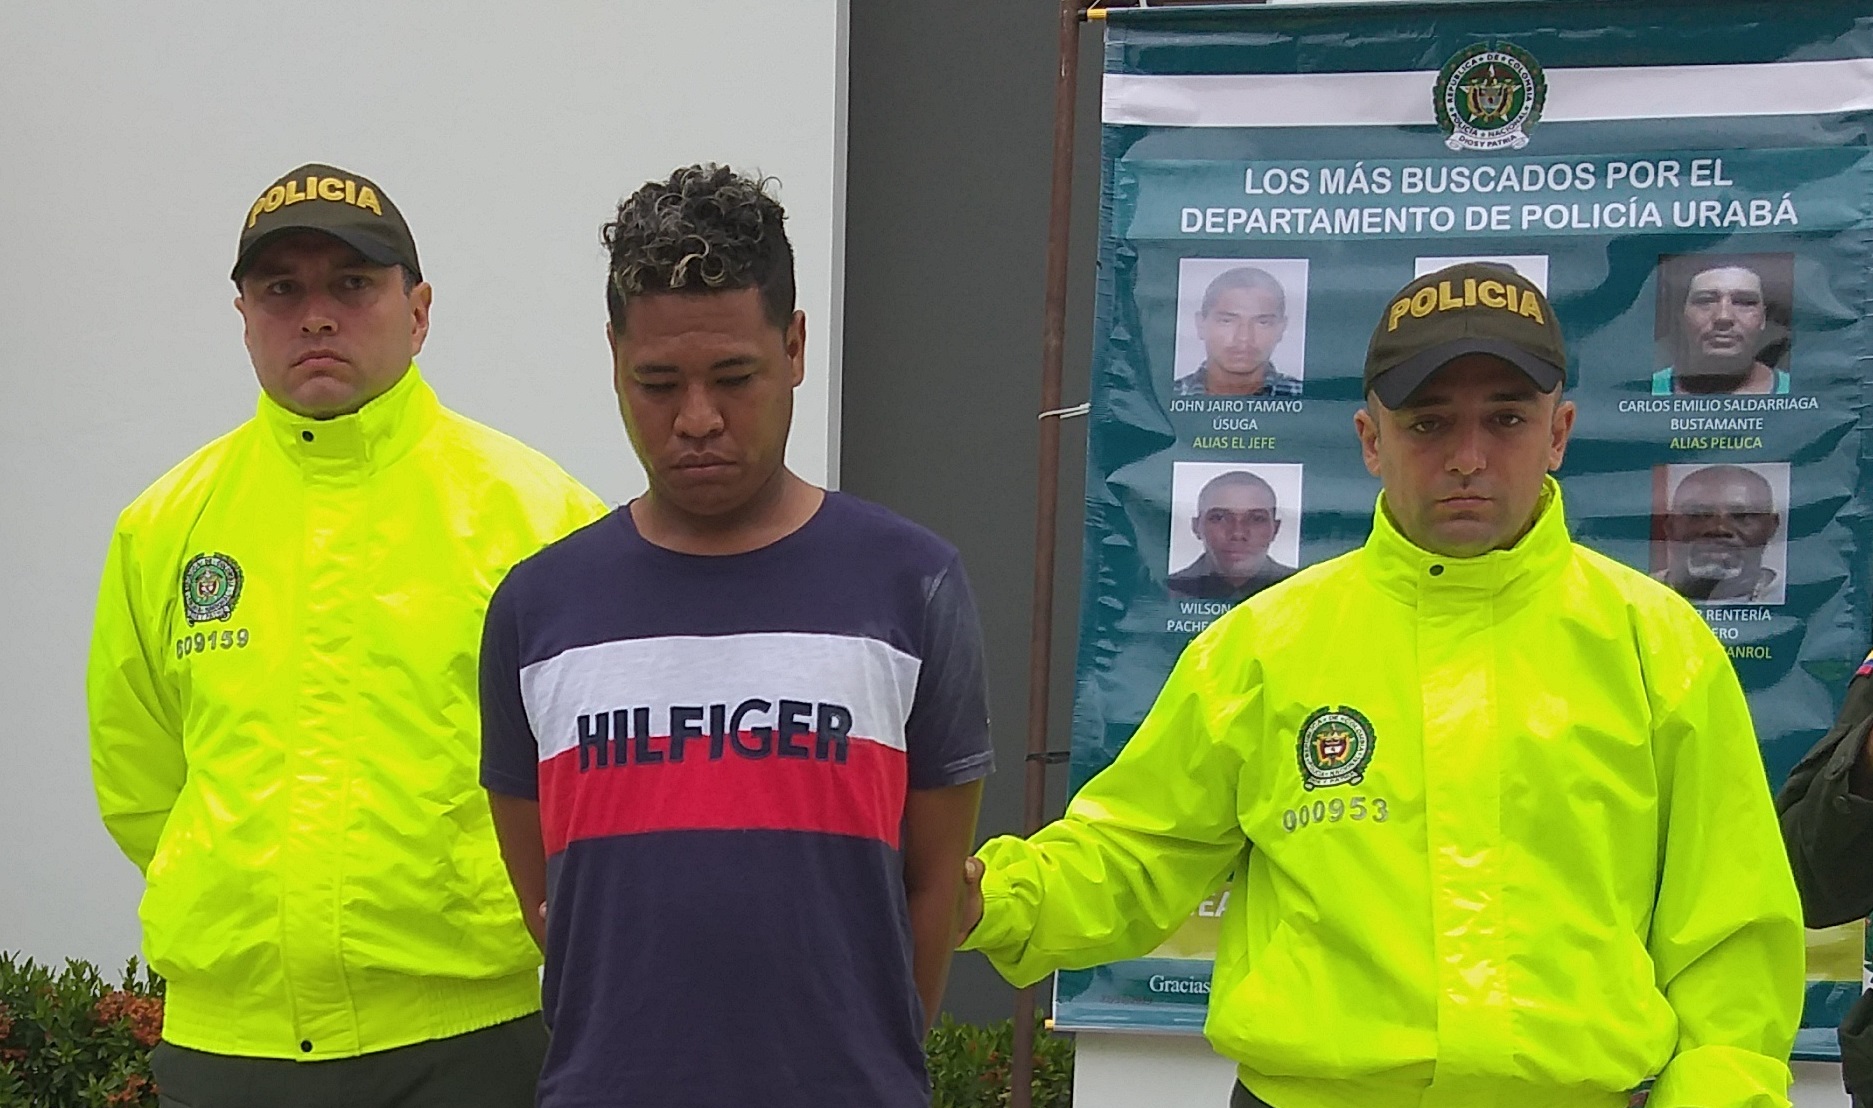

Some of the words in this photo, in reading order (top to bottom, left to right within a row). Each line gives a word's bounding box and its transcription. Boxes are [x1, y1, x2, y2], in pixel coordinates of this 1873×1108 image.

[1508, 60, 1533, 102] COLOMBIA
[1488, 112, 1528, 137] NACIONAL
[1487, 134, 1517, 147] PATRIA
[1245, 167, 1310, 195] LOS
[1319, 161, 1392, 195] MÁS
[1401, 162, 1596, 194] BUSCADOS
[1607, 160, 1680, 190] POR
[1690, 158, 1733, 187] EL
[248, 176, 383, 229] POLICIA
[1180, 206, 1456, 234] DEPARTAMENTO
[1465, 205, 1512, 232] DE
[1521, 196, 1663, 230] POLICÍA
[1673, 192, 1799, 228] URABÁ
[1388, 278, 1545, 332] POLICIA
[1169, 400, 1204, 412] JOHN
[1206, 400, 1243, 413] JAIRO
[1247, 400, 1303, 413] TAMAYO
[1618, 399, 1670, 413] CARLOS
[1673, 399, 1721, 412] EMILIO
[1723, 397, 1819, 412] SALDARRIAGA
[1212, 415, 1258, 431] ÚSUGA
[1670, 417, 1763, 430] BUSTAMANTE
[1192, 436, 1228, 449] ALIAS
[1231, 437, 1245, 449] EL
[1247, 437, 1276, 449] JEFE
[1670, 437, 1708, 449] ALIAS
[1711, 437, 1763, 449] PELUCA
[1180, 602, 1231, 615] WILSON
[1706, 605, 1772, 621] RENTERÍA
[1166, 620, 1212, 632] PACHE
[577, 698, 853, 773] HILFIGER
[1282, 796, 1389, 833] 000953
[1149, 974, 1211, 994] Gracias
